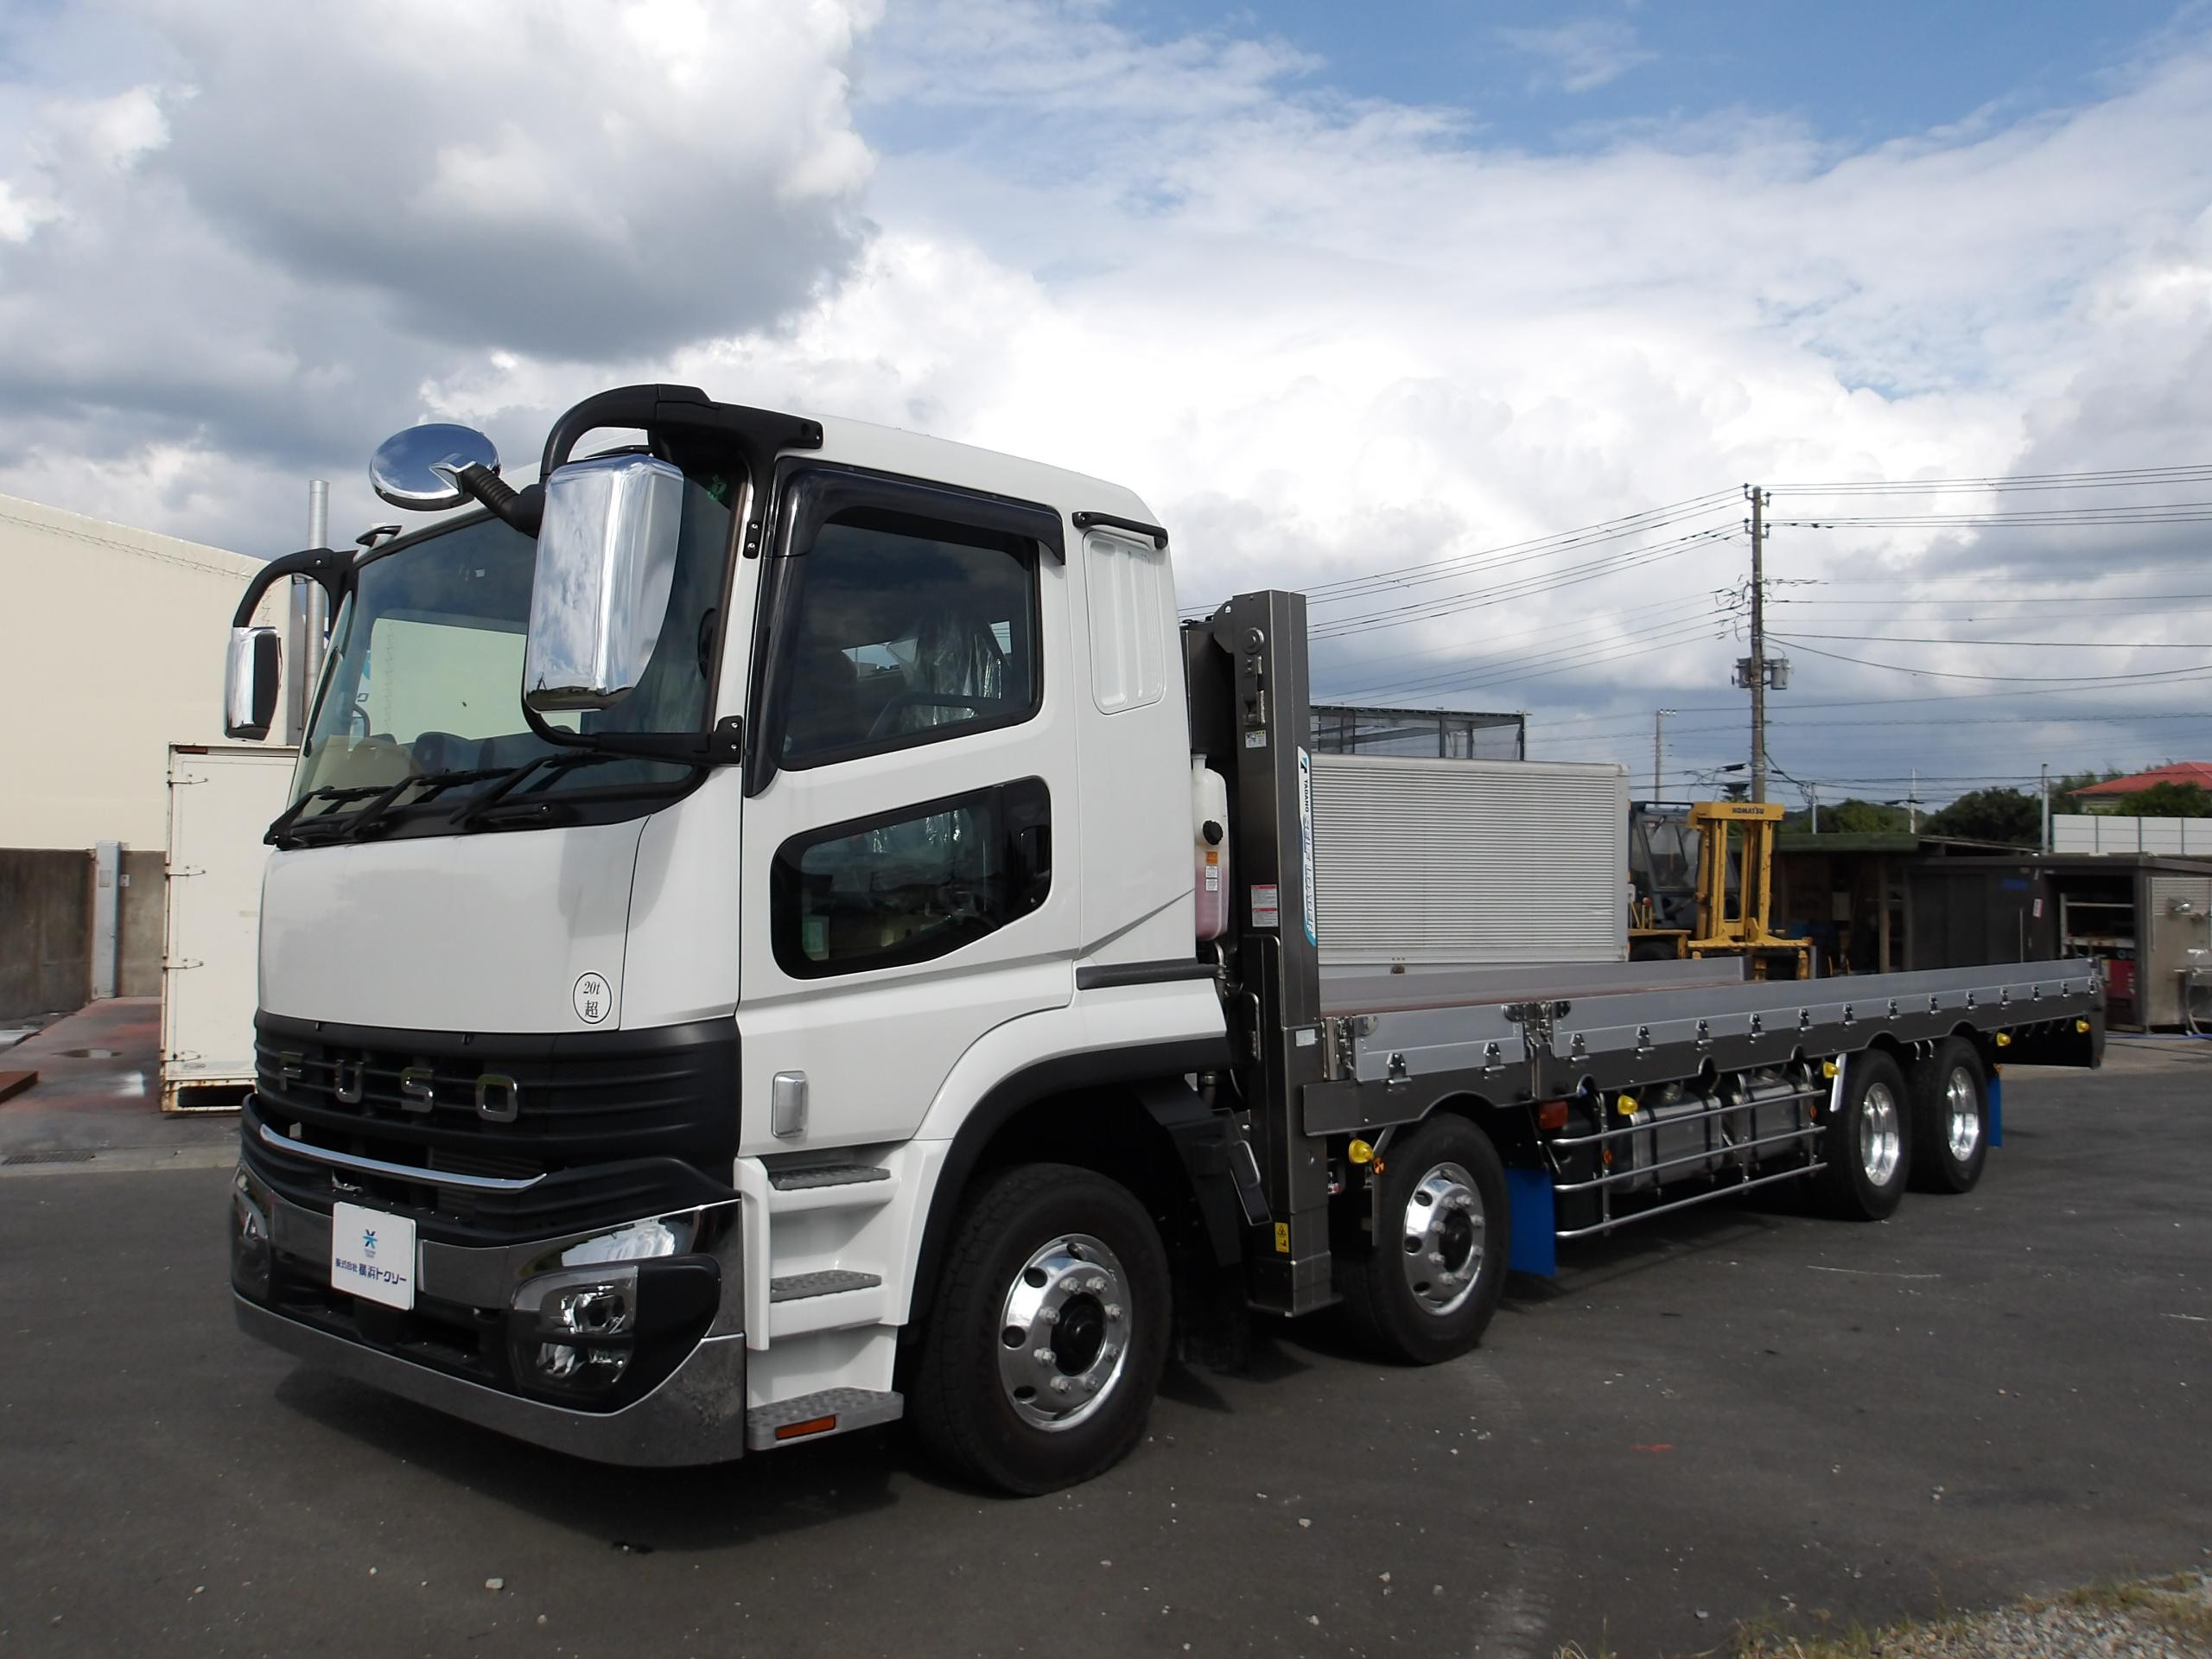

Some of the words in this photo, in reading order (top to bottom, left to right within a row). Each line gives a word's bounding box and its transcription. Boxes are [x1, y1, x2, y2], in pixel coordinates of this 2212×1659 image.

[583, 981, 601, 995] 20t
[584, 1000, 599, 1018] 超
[278, 1051, 518, 1122] FUSO
